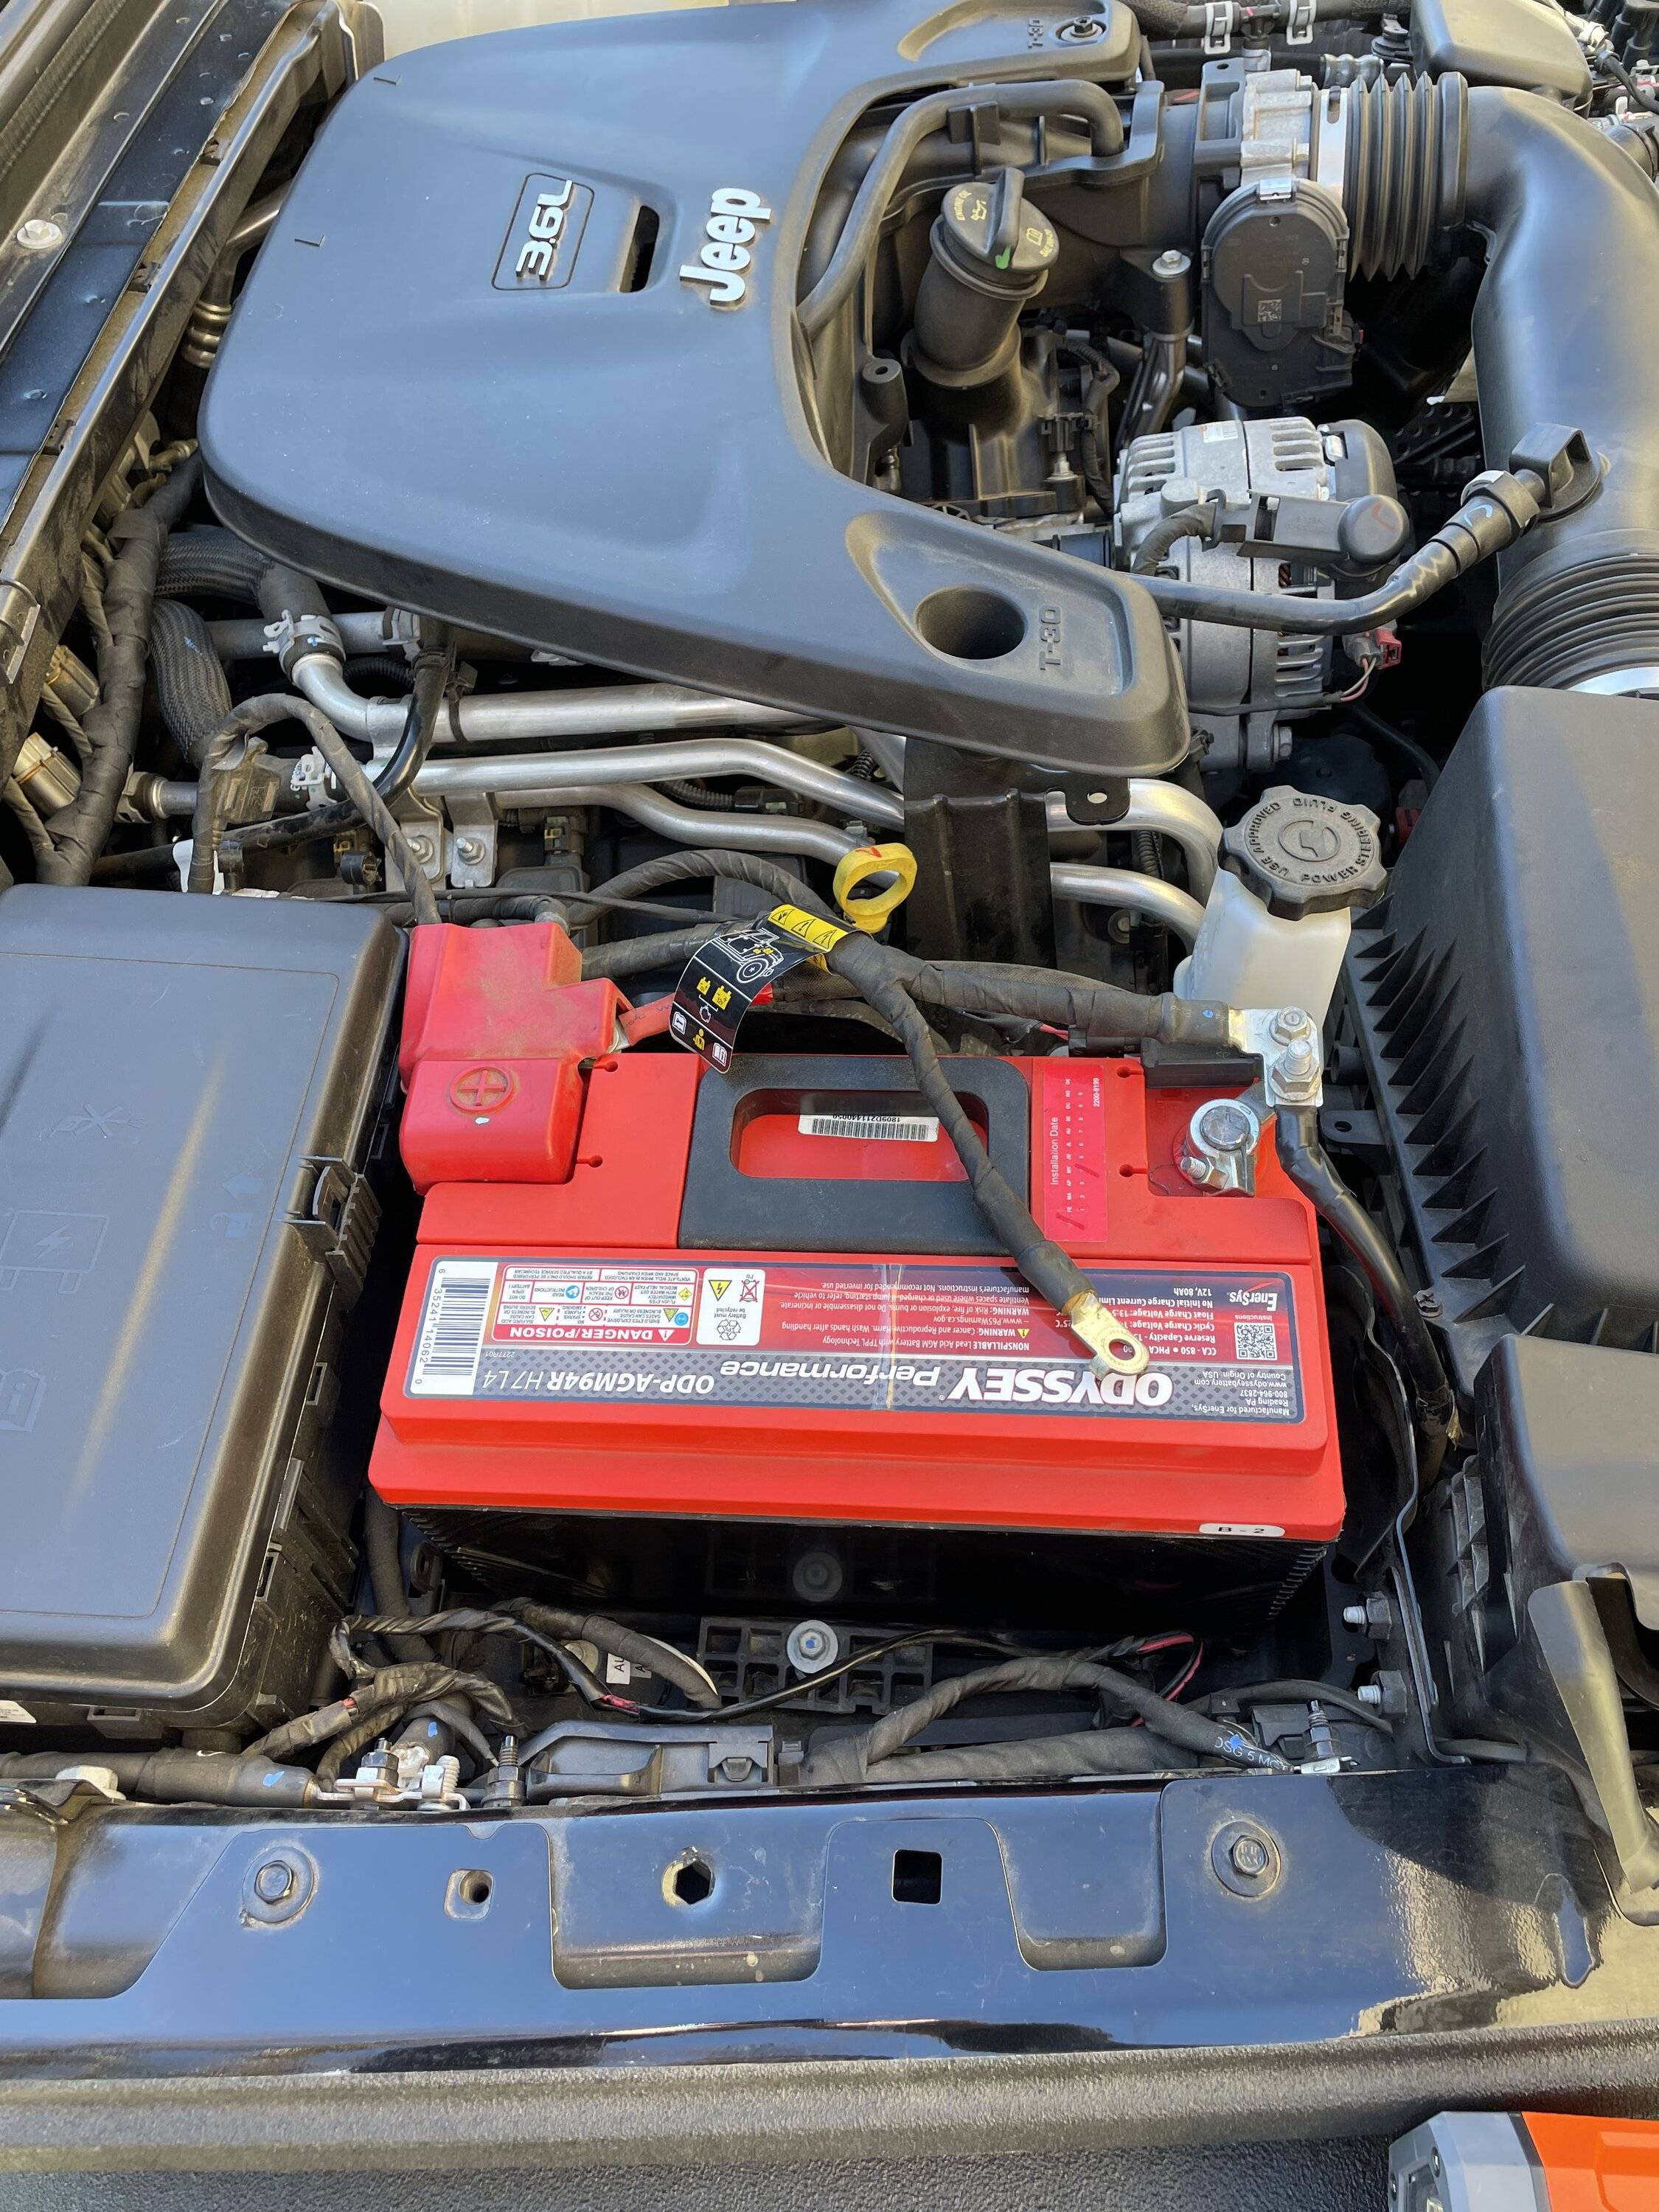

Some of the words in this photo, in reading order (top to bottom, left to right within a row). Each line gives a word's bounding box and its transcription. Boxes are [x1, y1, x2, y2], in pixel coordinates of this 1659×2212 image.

[515, 180, 573, 280] 3.6L
[679, 187, 771, 305] Jeep
[1039, 605, 1062, 670] T-30
[1293, 798, 1338, 813] FLUID
[1248, 801, 1281, 855] APPROVED
[1340, 811, 1371, 867] STEERING
[1260, 855, 1290, 877] USE
[1301, 866, 1358, 883] POWER
[1050, 1117, 1058, 1136] Date
[1050, 1139, 1059, 1185] Installation
[835, 1283, 863, 1291] inverted
[936, 1285, 978, 1293] instructions.
[1173, 1288, 1194, 1296] 80Ah
[1194, 1287, 1212, 1296] 12V,
[818, 1293, 826, 1301] to
[844, 1291, 871, 1301] starting,
[953, 1295, 975, 1304] where
[975, 1294, 998, 1302] spaces
[999, 1297, 1029, 1305] Ventilate
[1099, 1297, 1115, 1305] Limi
[1228, 1289, 1277, 1311] EnerSys
[428, 1288, 442, 1321] 35241
[779, 1302, 813, 1310] incinerate.
[1116, 1298, 1146, 1306] Current
[1147, 1296, 1175, 1307] Charge
[1177, 1300, 1200, 1308] Initial
[823, 1303, 863, 1312] disassemble
[877, 1304, 886, 1312] Do
[918, 1303, 950, 1313] explosion
[951, 1304, 964, 1314] fire,
[975, 1307, 988, 1315] Risk
[990, 1307, 1029, 1315] WARNING:
[1130, 1307, 1162, 1318] Voltage:
[1164, 1309, 1192, 1319] Charge
[1193, 1312, 1214, 1320] Float
[933, 1314, 1022, 1326] www.P65Warnings.ca.gov
[1130, 1319, 1163, 1330] Voltage:
[782, 1321, 811, 1332] handling
[813, 1324, 829, 1332] after
[830, 1324, 850, 1332] hands
[852, 1325, 870, 1333] Wash
[872, 1326, 891, 1334] Harm.
[891, 1324, 936, 1335] Reproductive
[938, 1327, 951, 1335] and
[952, 1327, 975, 1335] Cancer
[1164, 1321, 1192, 1331] Charge
[1193, 1321, 1215, 1332] Cyclic
[510, 1327, 653, 1340] DANGER/POISON
[976, 1328, 1016, 1337] WARNING:
[1149, 1332, 1181, 1343] Capacity
[822, 1335, 860, 1346] Technology
[861, 1338, 877, 1347] TPPL
[879, 1339, 892, 1347] with
[896, 1337, 920, 1348] Battery
[1181, 1335, 1215, 1343] Reserve
[419, 1329, 434, 1363] 14062
[922, 1340, 938, 1349] AGM
[939, 1340, 954, 1349] Acid
[956, 1340, 972, 1349] Lead
[973, 1341, 1029, 1350] NONSPILLABLE
[1149, 1346, 1170, 1354] PHCA
[1180, 1346, 1196, 1355] 850
[1202, 1347, 1217, 1355] CCA
[720, 1360, 941, 1386] Performance
[1202, 1371, 1218, 1379] USA
[1256, 1370, 1286, 1380] Country
[481, 1369, 509, 1388] L4
[510, 1370, 544, 1389] H7
[546, 1371, 714, 1394] ODP-AGM94R
[1194, 1377, 1287, 1389] www.odysseybattery.com
[945, 1367, 1174, 1407] ODYSSEY
[1240, 1390, 1287, 1398] 800-964-2837
[1257, 1397, 1289, 1407] Reading
[1192, 1403, 1225, 1414] EnerSys,
[1239, 1407, 1290, 1416] Manufactured
